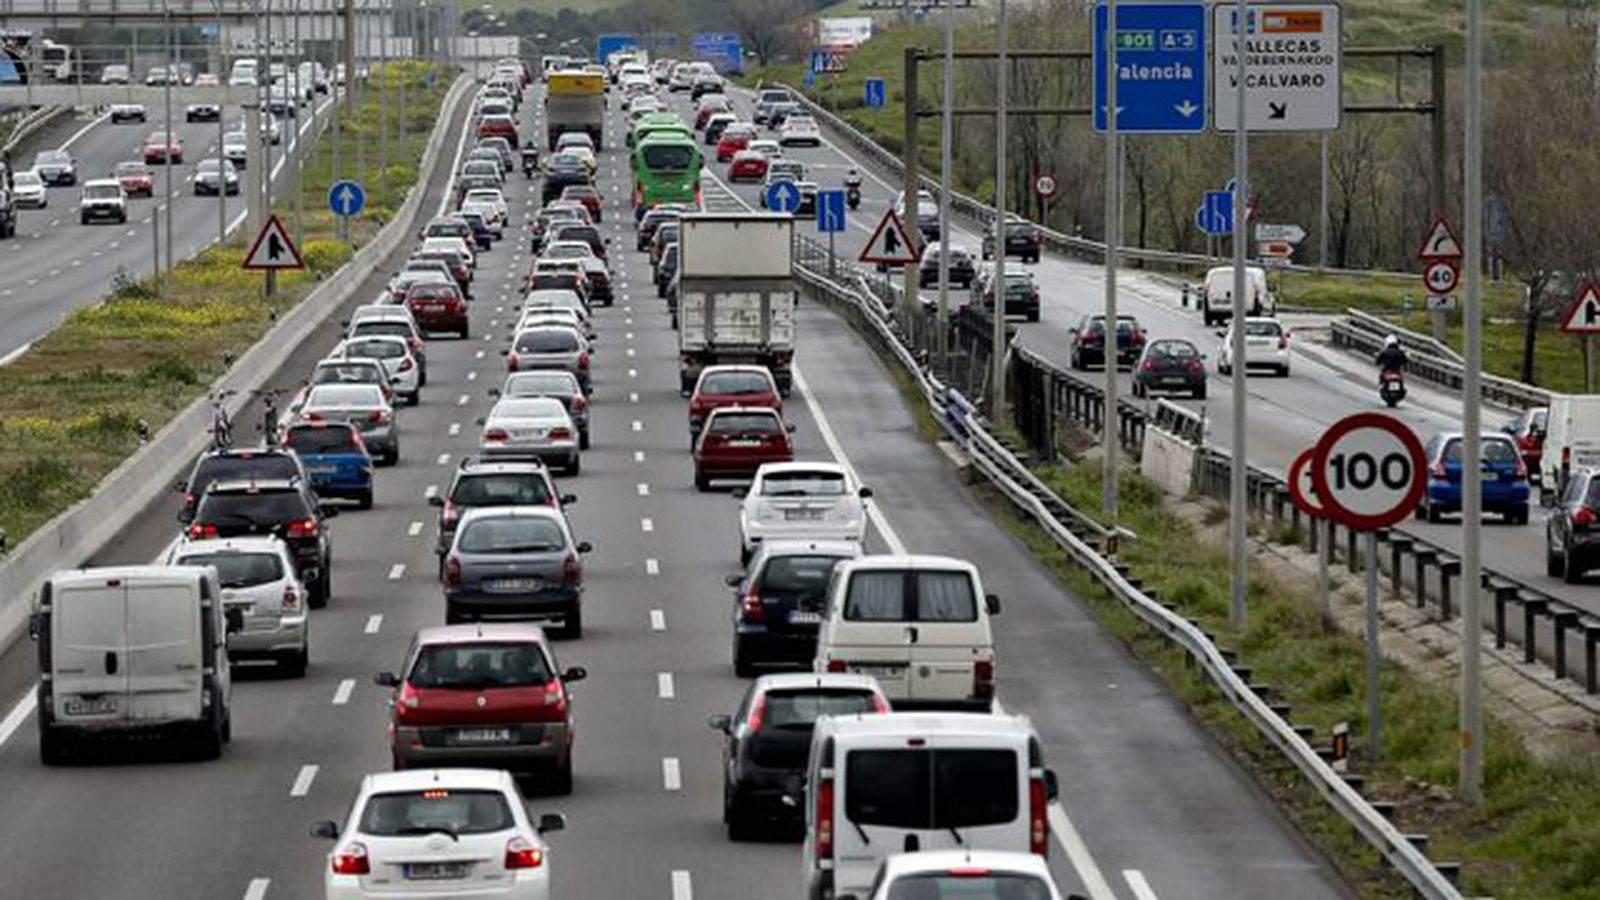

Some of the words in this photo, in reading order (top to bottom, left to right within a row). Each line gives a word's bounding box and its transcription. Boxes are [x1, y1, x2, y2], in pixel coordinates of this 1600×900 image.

[1222, 55, 1334, 65] VADEBERNARDO
[1229, 74, 1325, 88] VCALVARO
[1430, 270, 1451, 283] 40
[1329, 452, 1411, 490] 100
